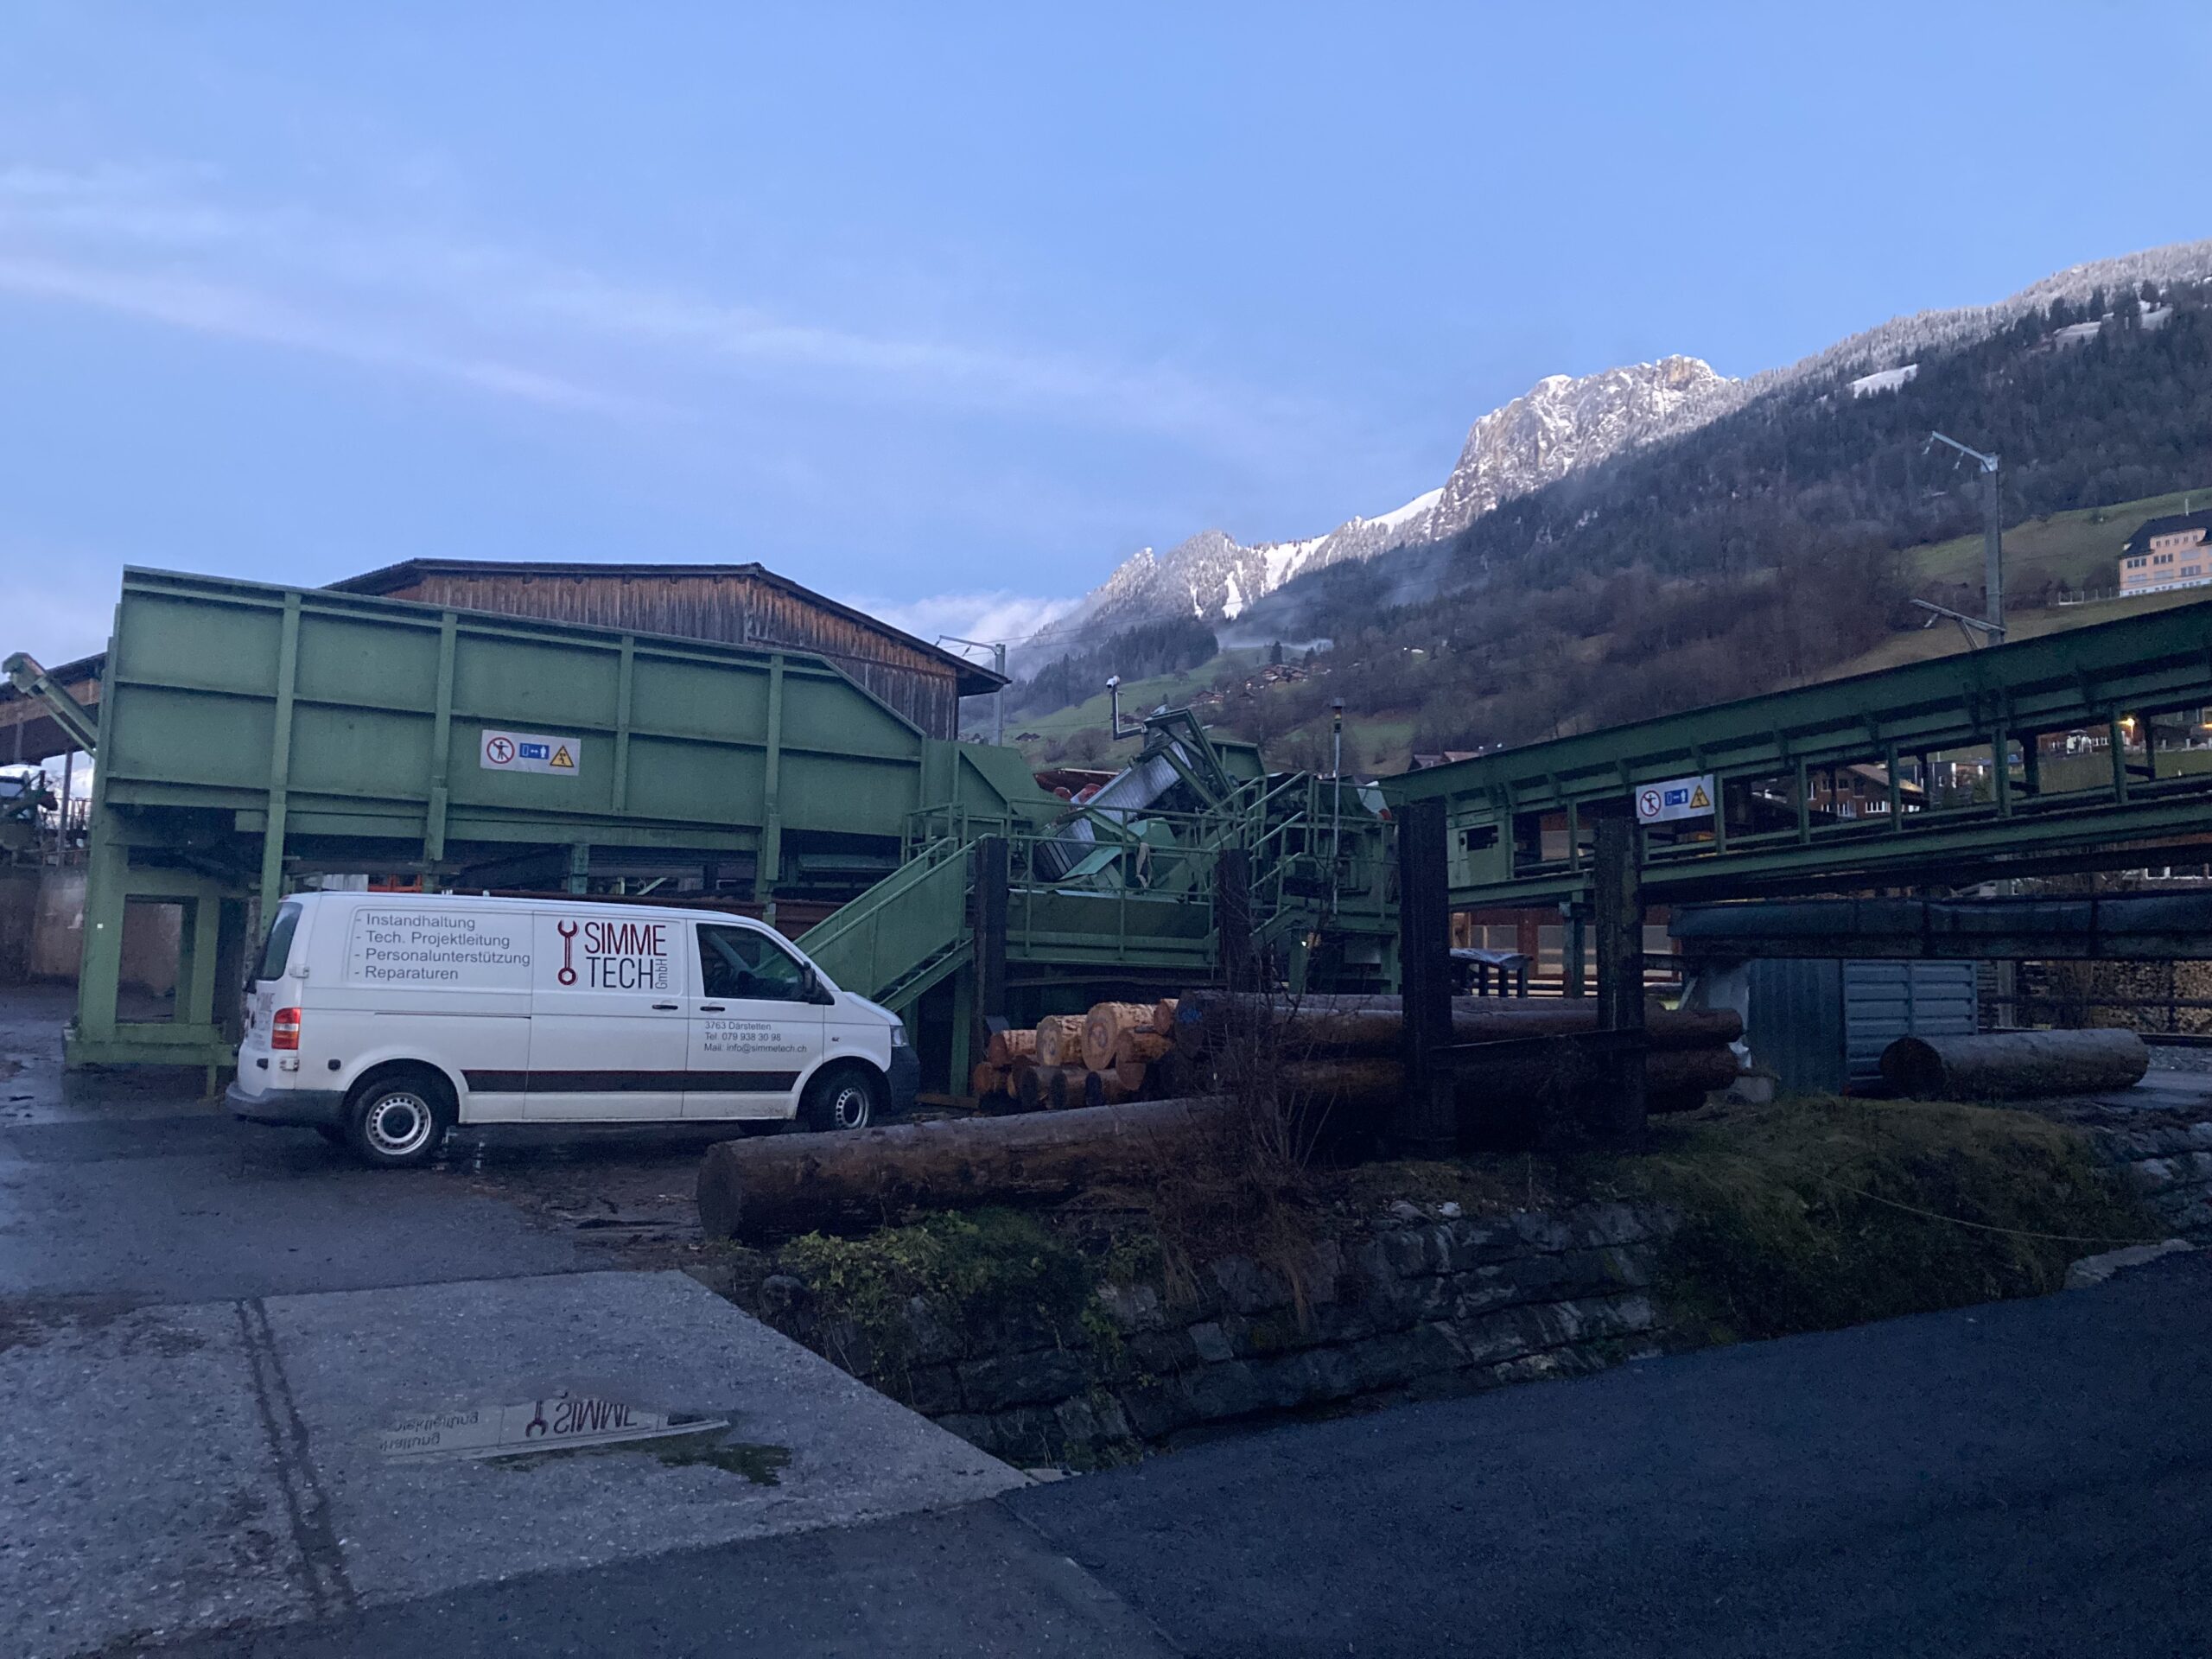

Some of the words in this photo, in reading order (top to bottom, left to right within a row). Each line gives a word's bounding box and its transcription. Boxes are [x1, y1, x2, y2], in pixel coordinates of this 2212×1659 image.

[366, 912, 475, 931] Instandhaltung
[365, 930, 405, 944] Tech.
[411, 931, 510, 950] Projektleitung
[584, 921, 668, 957] SIMME
[365, 947, 531, 967] Personalunterstützung
[365, 965, 459, 981] Reparaturen
[585, 957, 653, 989] TECH
[654, 958, 668, 989] GmbH
[705, 1020, 727, 1030] 3763
[721, 1033, 738, 1041] 079
[758, 1033, 769, 1041] 30
[727, 1043, 807, 1054] info@simmetech.ch
